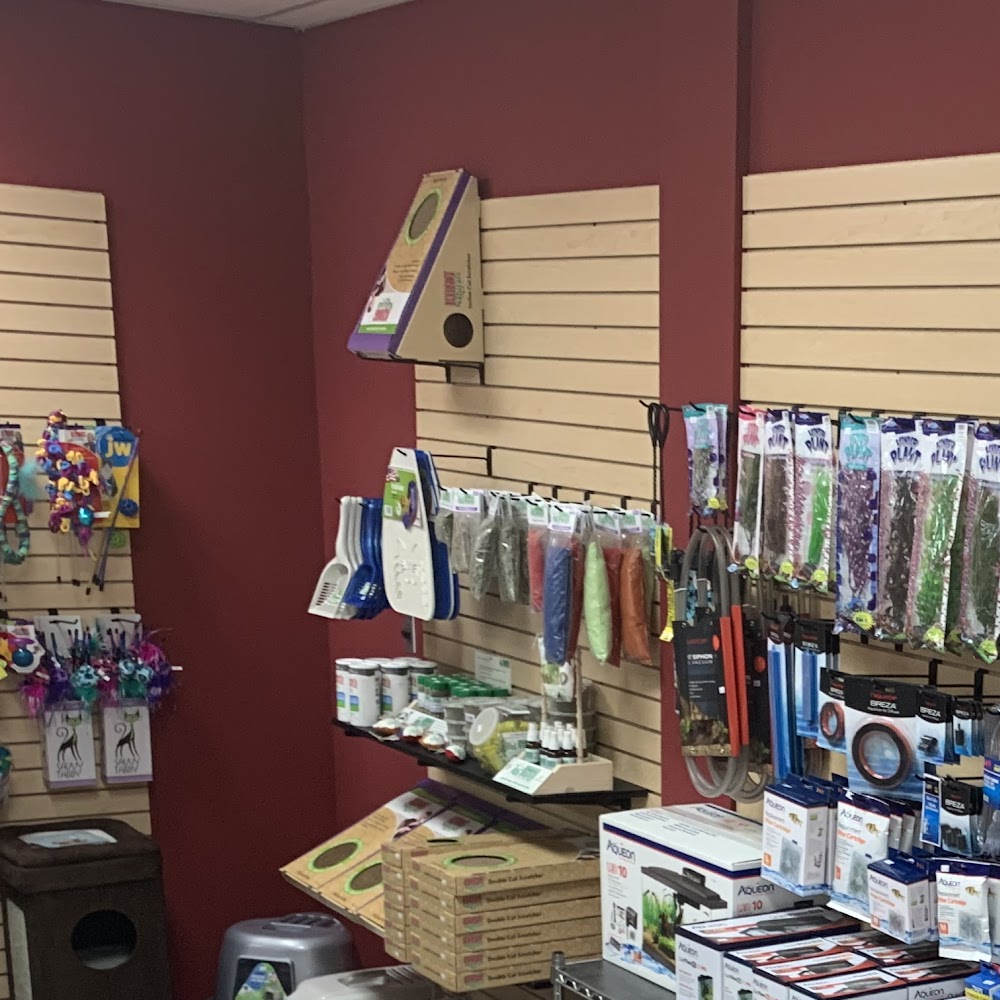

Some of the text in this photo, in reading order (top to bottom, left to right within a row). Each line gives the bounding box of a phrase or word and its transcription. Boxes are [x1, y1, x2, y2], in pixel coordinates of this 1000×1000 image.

[870, 700, 897, 710] BREZA
[920, 706, 941, 718] BREZA
[945, 799, 966, 810] BREZA
[618, 866, 627, 879] 10
[752, 901, 762, 910] 10
